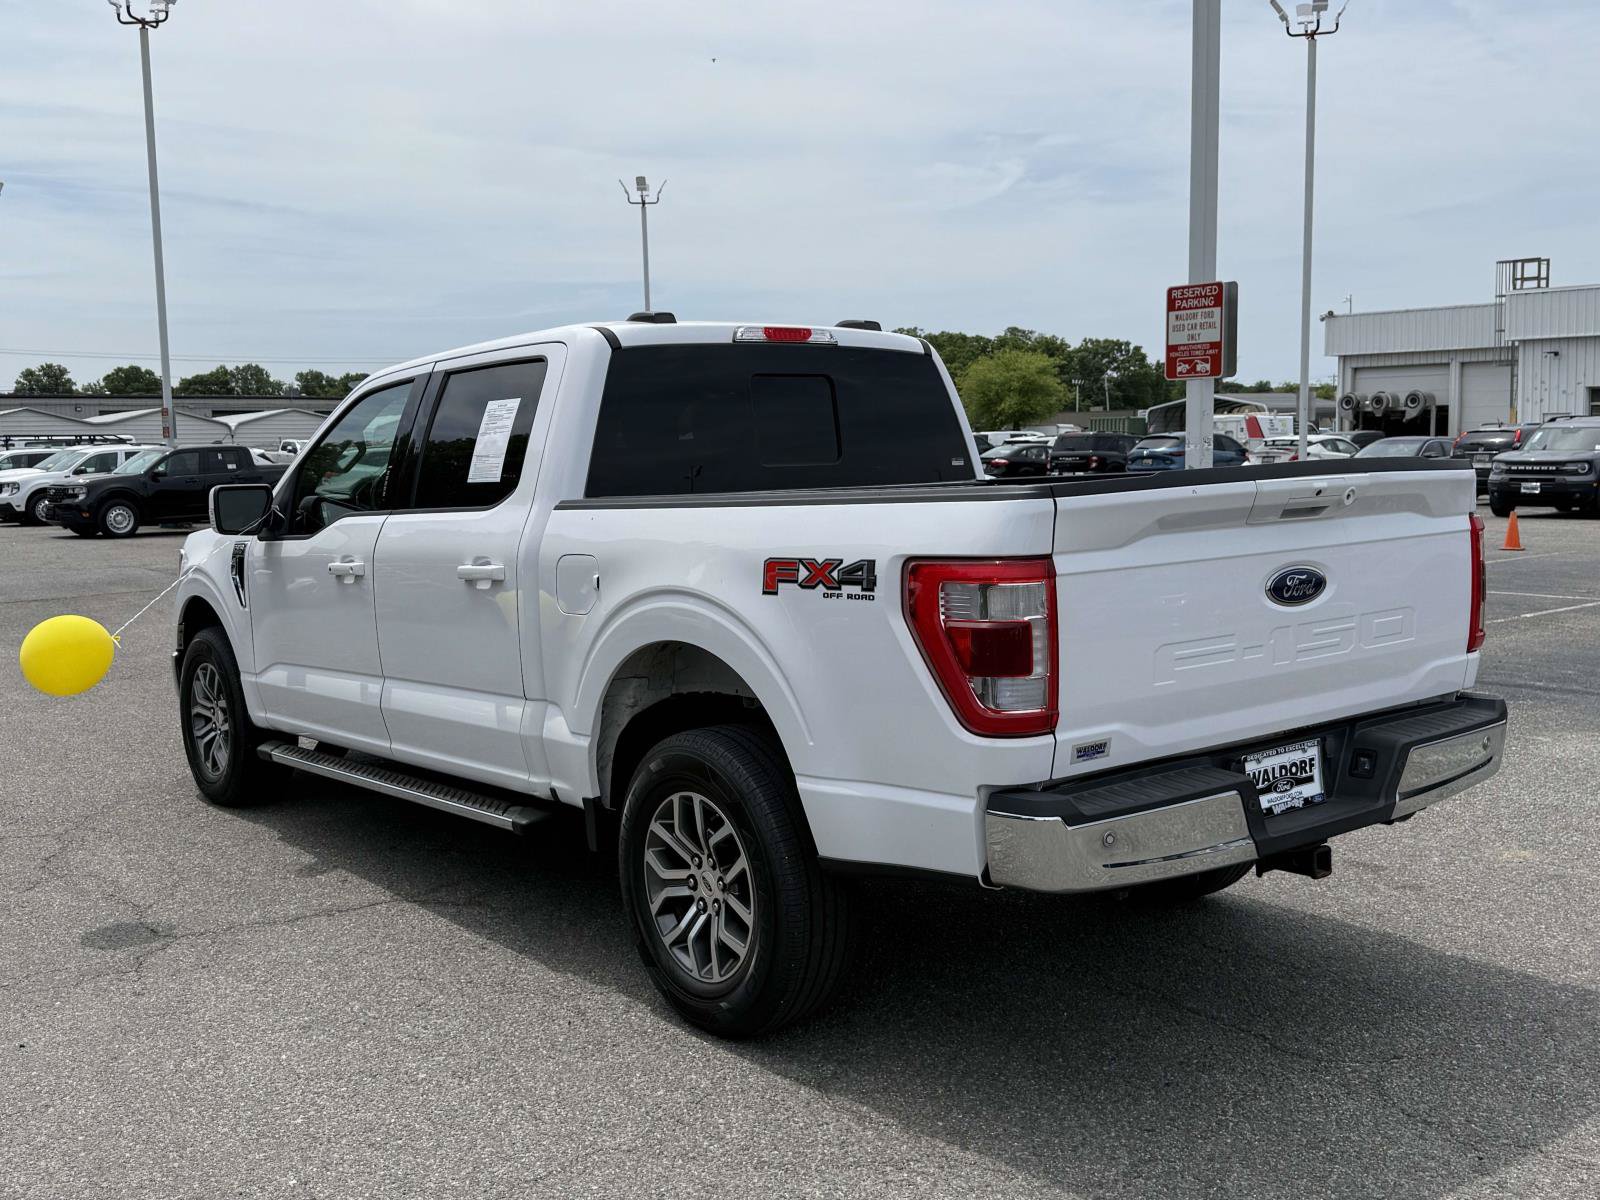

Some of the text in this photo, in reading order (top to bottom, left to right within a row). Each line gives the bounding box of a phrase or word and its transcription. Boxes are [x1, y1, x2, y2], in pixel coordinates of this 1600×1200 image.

[1171, 285, 1218, 299] RESERVED
[1175, 296, 1215, 309] PARKING
[1175, 310, 1215, 321] WALDORF FORD
[1172, 321, 1217, 332] USED CAR RETAIL
[1187, 333, 1201, 341] ONLY
[762, 557, 877, 596] FX4
[1283, 574, 1316, 598] Ford
[846, 593, 875, 601] ROAD
[1153, 606, 1416, 686] F-150
[1246, 750, 1277, 760] DEDICATED
[1285, 740, 1318, 752] EXCELLENCE
[1246, 756, 1316, 788] WALDORF
[1276, 781, 1292, 793] Ford
[1272, 797, 1305, 815] WALDORF
